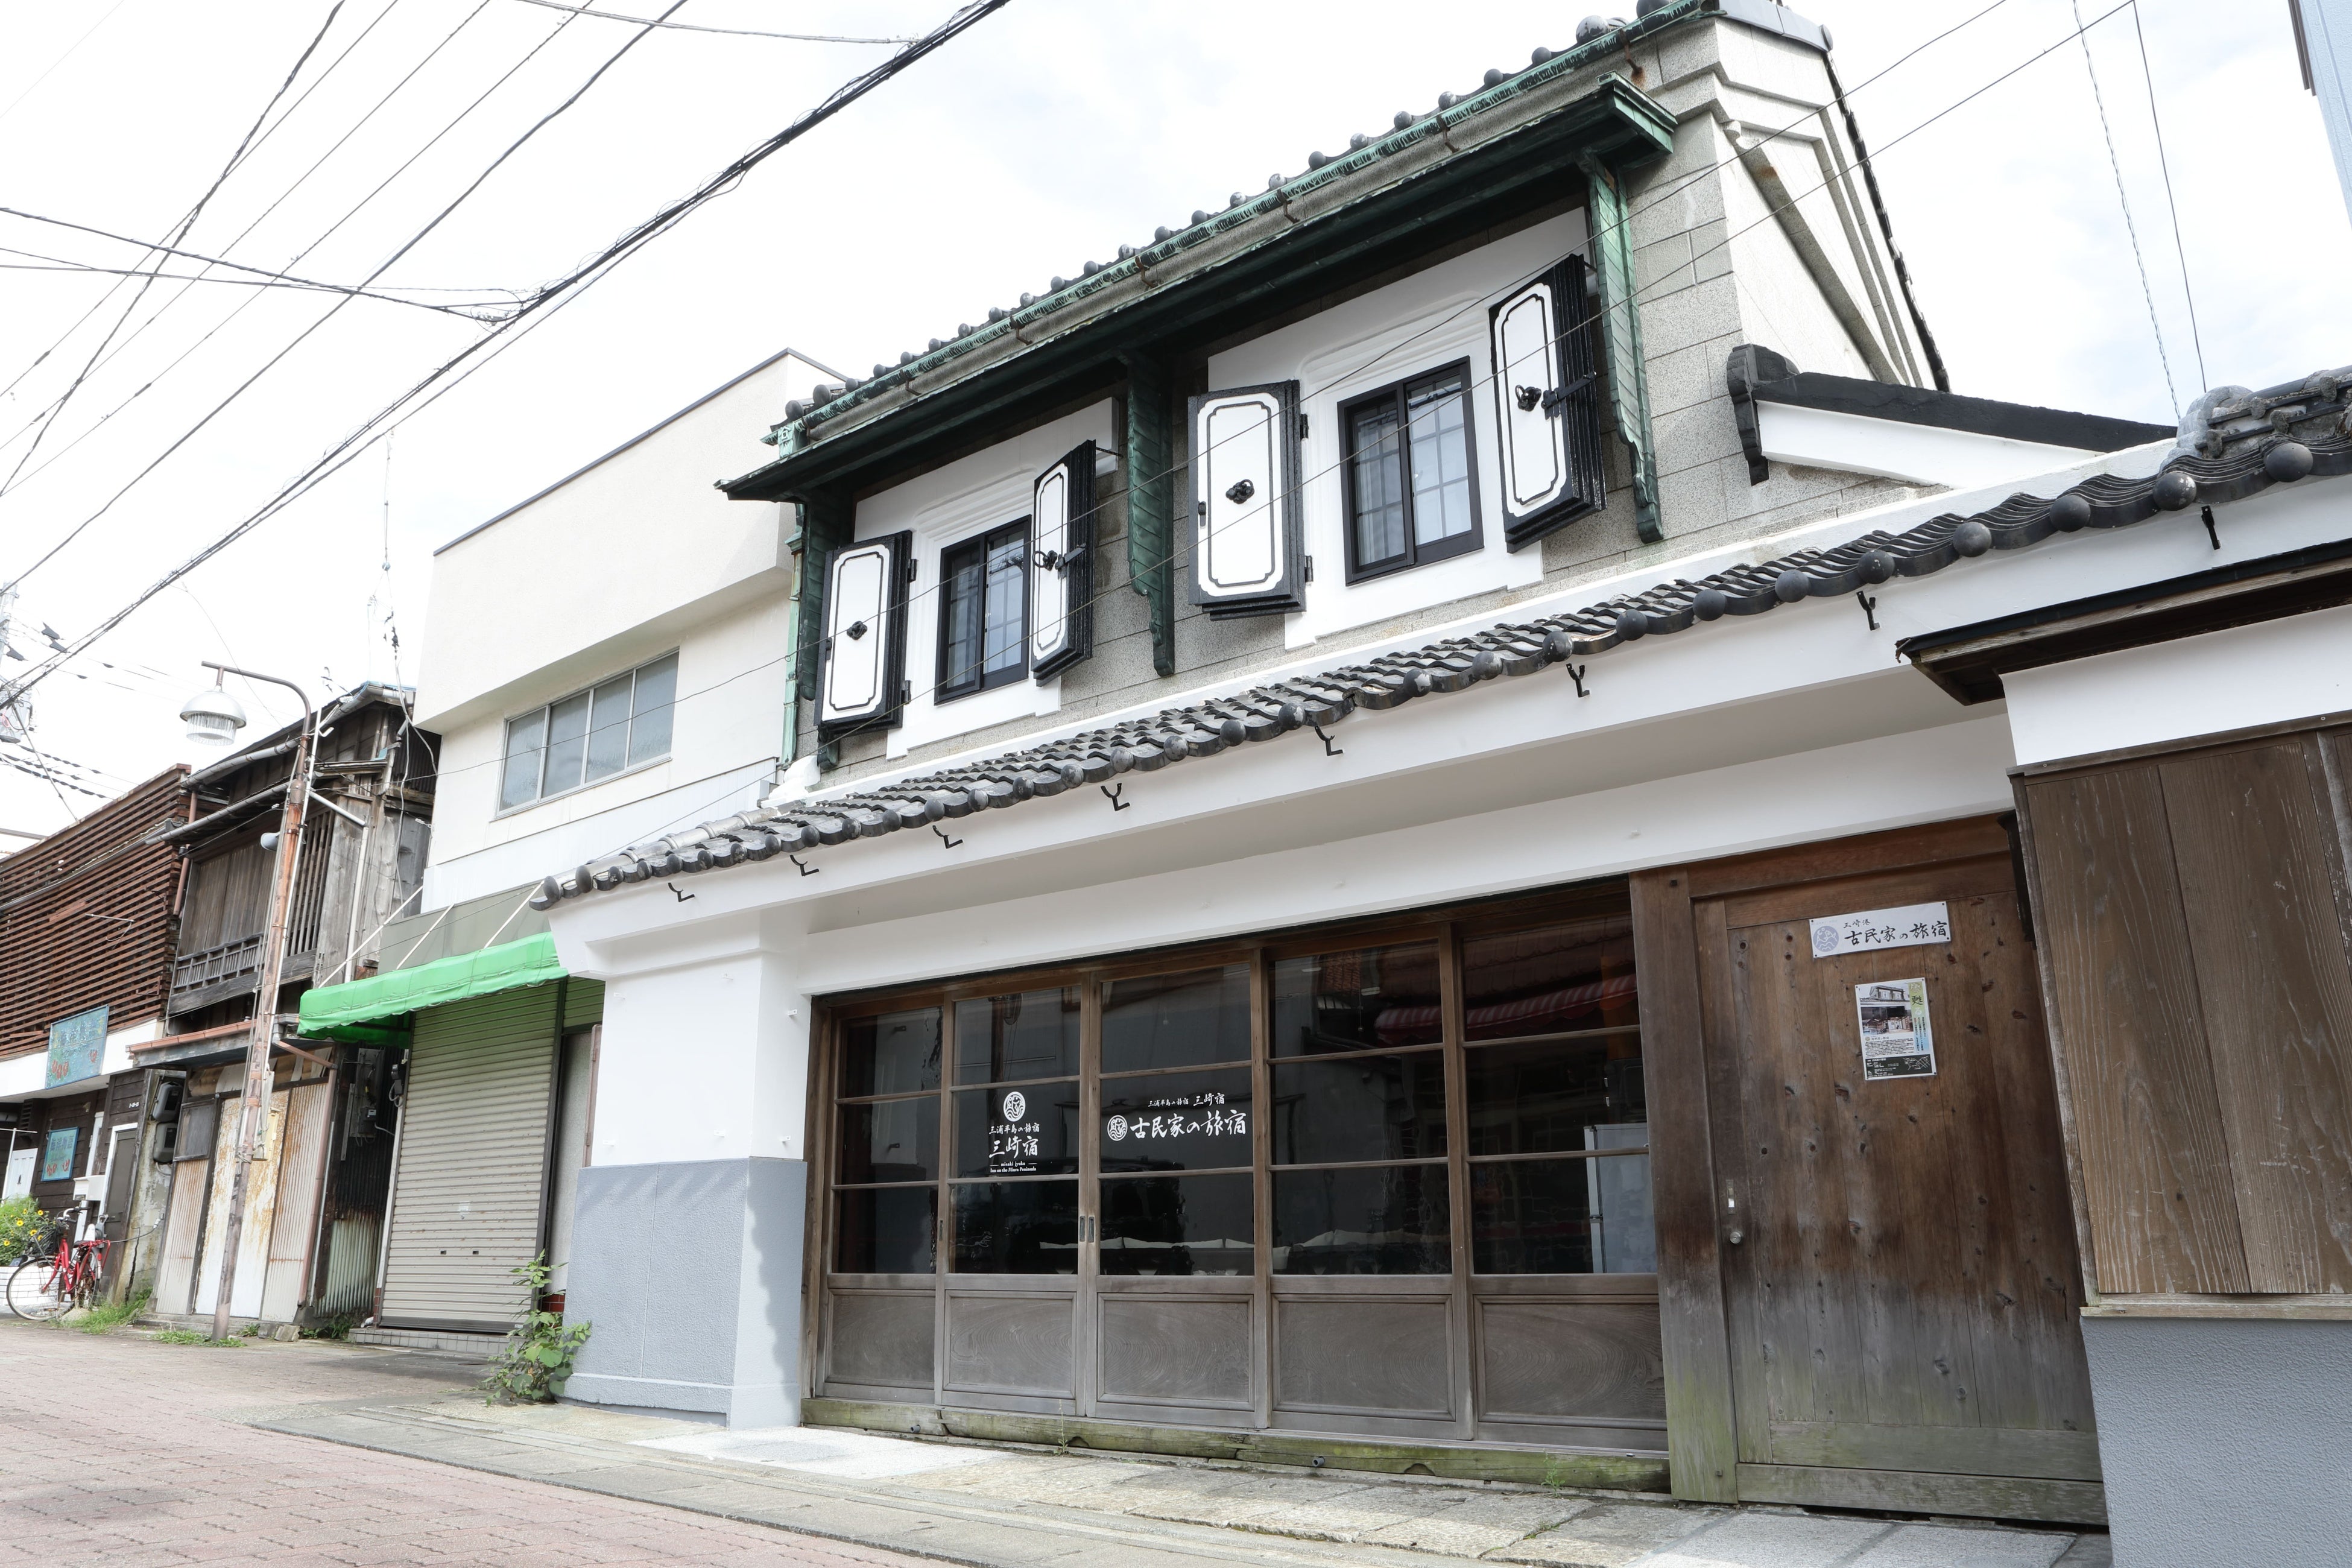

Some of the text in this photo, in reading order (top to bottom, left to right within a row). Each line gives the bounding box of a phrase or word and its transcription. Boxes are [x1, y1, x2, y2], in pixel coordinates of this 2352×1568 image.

[1844, 920, 1948, 946] 古民家の旅宿
[1148, 1093, 1225, 1107] 三浦半島の旅宿 三崎宿
[989, 1122, 1040, 1134] 三浦半島の旅宿
[1130, 1110, 1247, 1139] 古民家の旅宿
[989, 1136, 1038, 1159] 三崎宿
